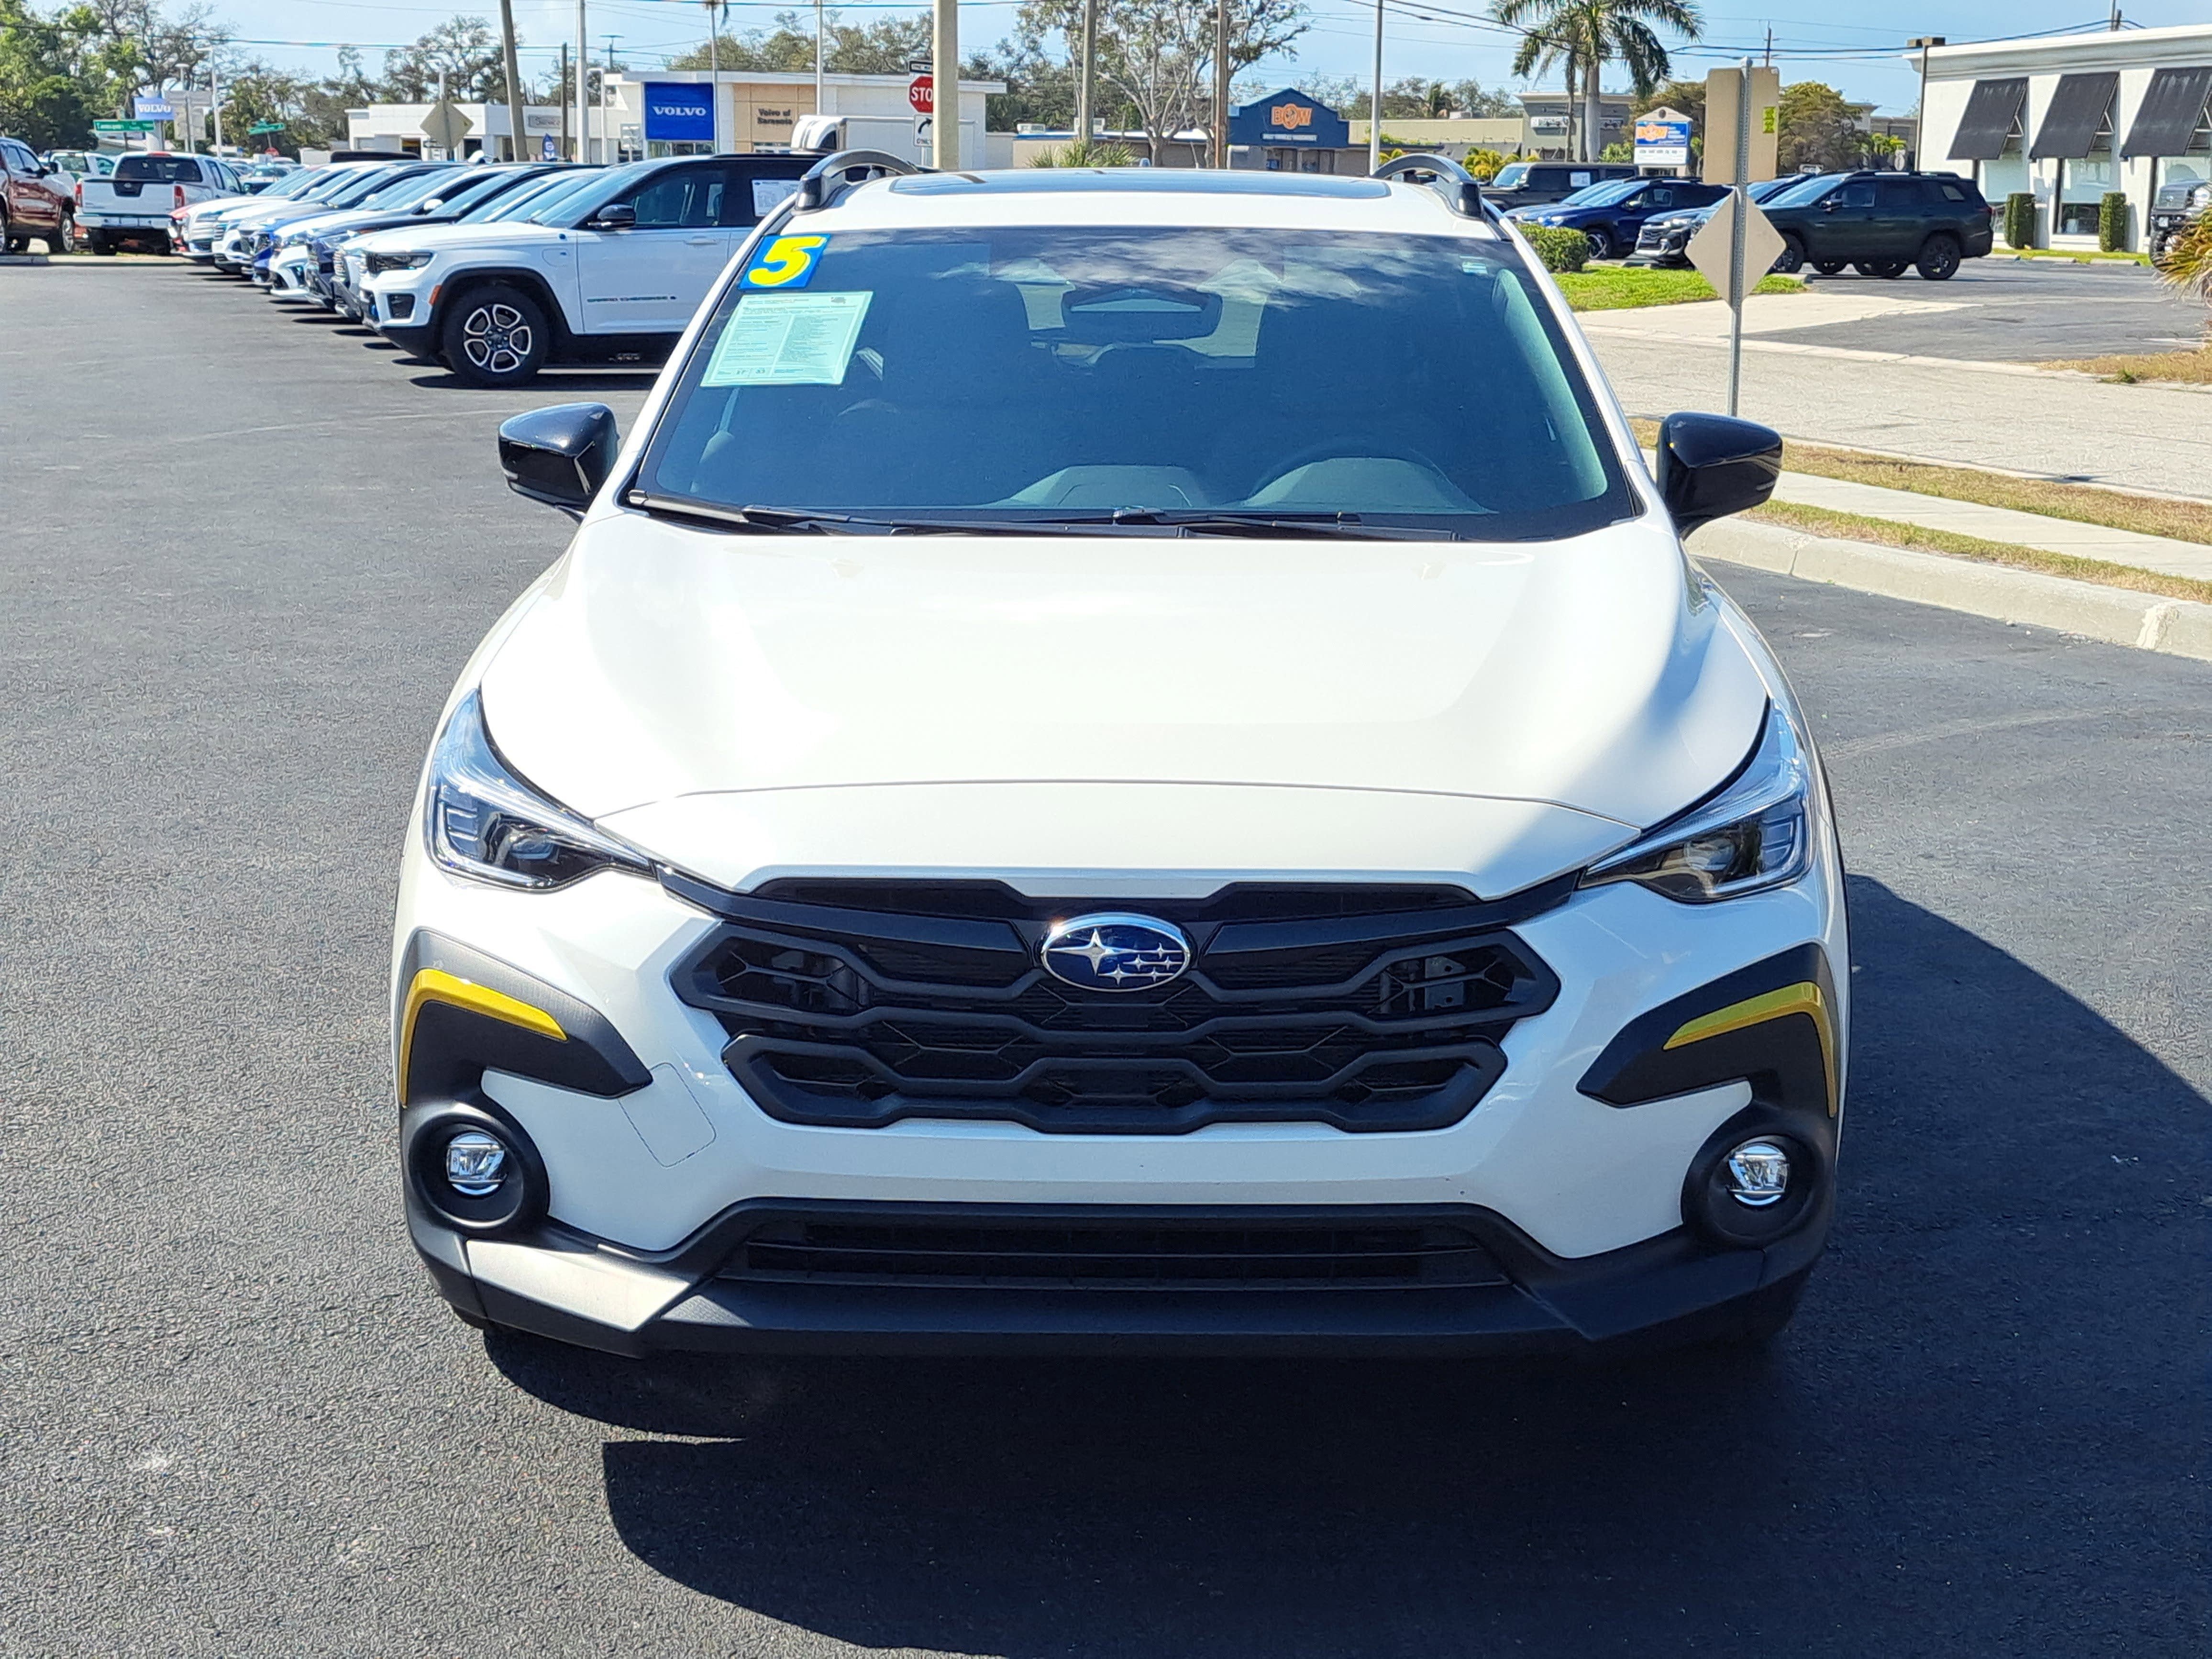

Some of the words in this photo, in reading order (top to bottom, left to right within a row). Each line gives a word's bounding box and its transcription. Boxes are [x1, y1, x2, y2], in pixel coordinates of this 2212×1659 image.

[911, 87, 933, 102] STO
[653, 106, 707, 116] VOLVO
[748, 236, 828, 287] 5
